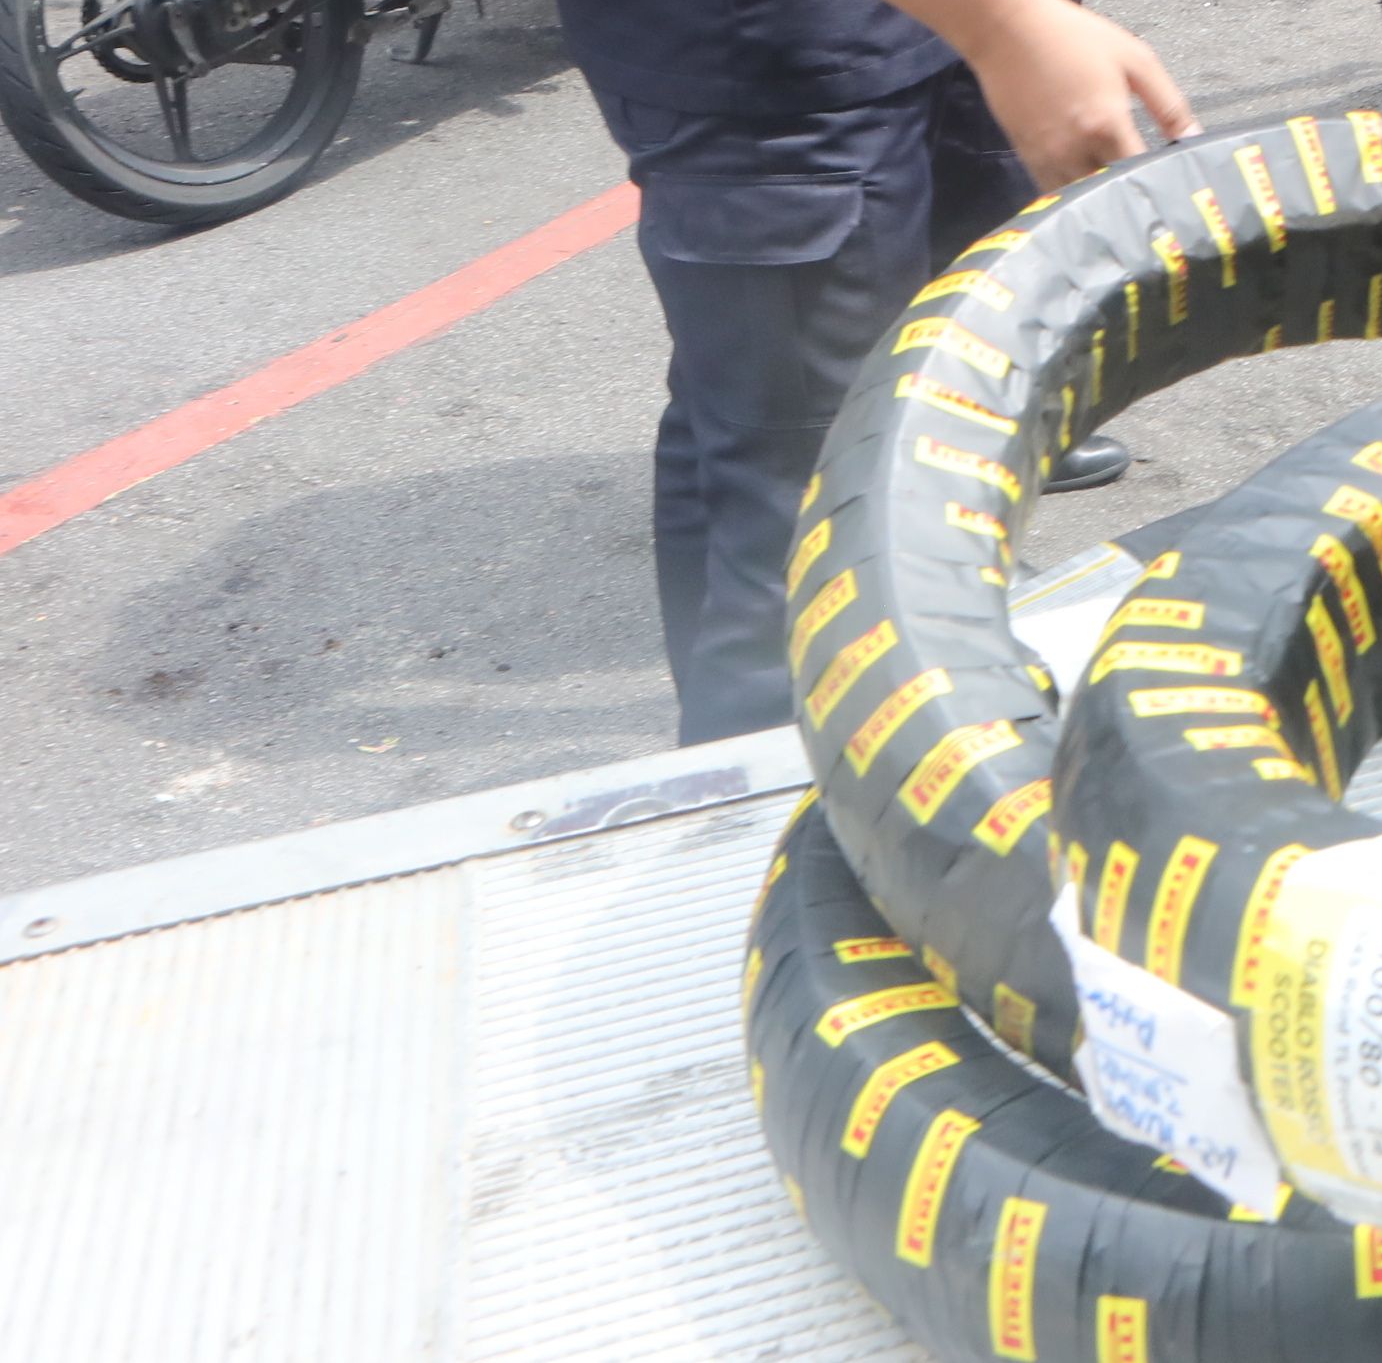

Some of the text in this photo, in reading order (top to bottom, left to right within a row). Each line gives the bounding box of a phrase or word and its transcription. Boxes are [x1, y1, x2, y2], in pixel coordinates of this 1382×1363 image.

[1269, 972, 1294, 1110] SCOOTER
[1296, 937, 1330, 1048] DIABLO
[1003, 1212, 1033, 1349] PIRELLI
